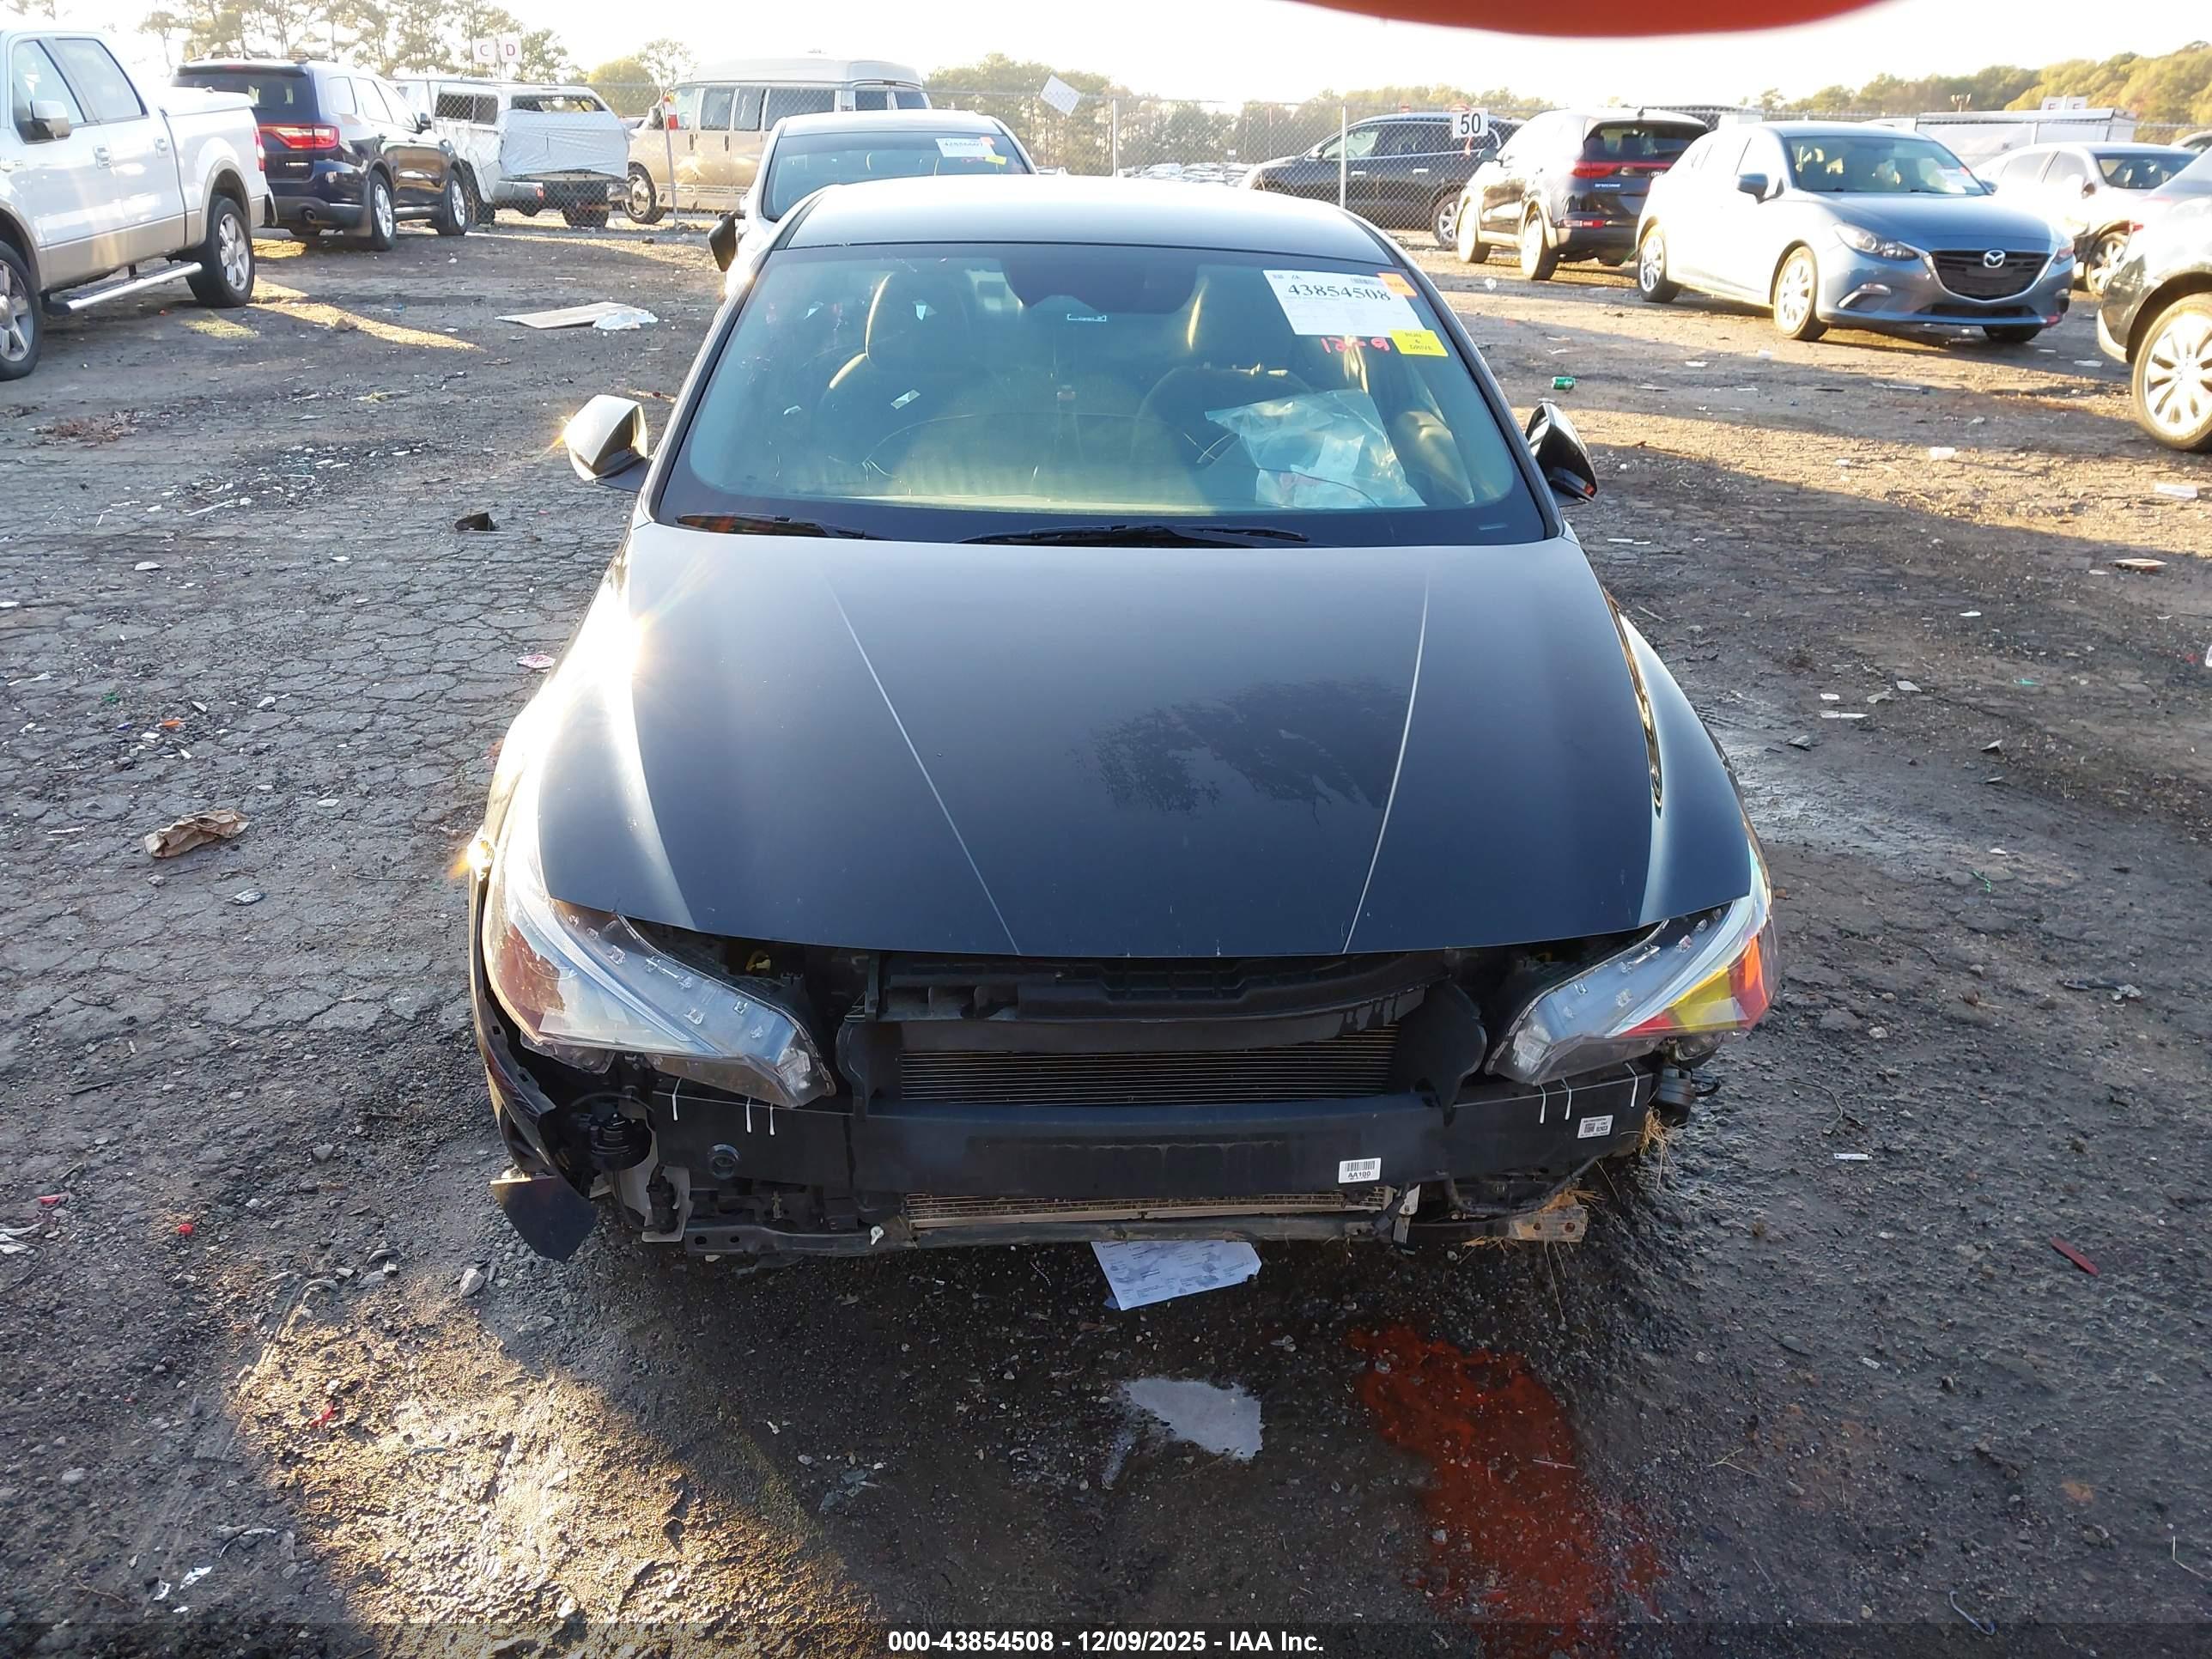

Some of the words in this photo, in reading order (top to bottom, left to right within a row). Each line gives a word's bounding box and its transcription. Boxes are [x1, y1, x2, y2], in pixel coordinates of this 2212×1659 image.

[480, 44, 489, 57] C
[506, 43, 515, 57] D
[1461, 112, 1481, 135] 50
[1288, 283, 1391, 301] 43854508
